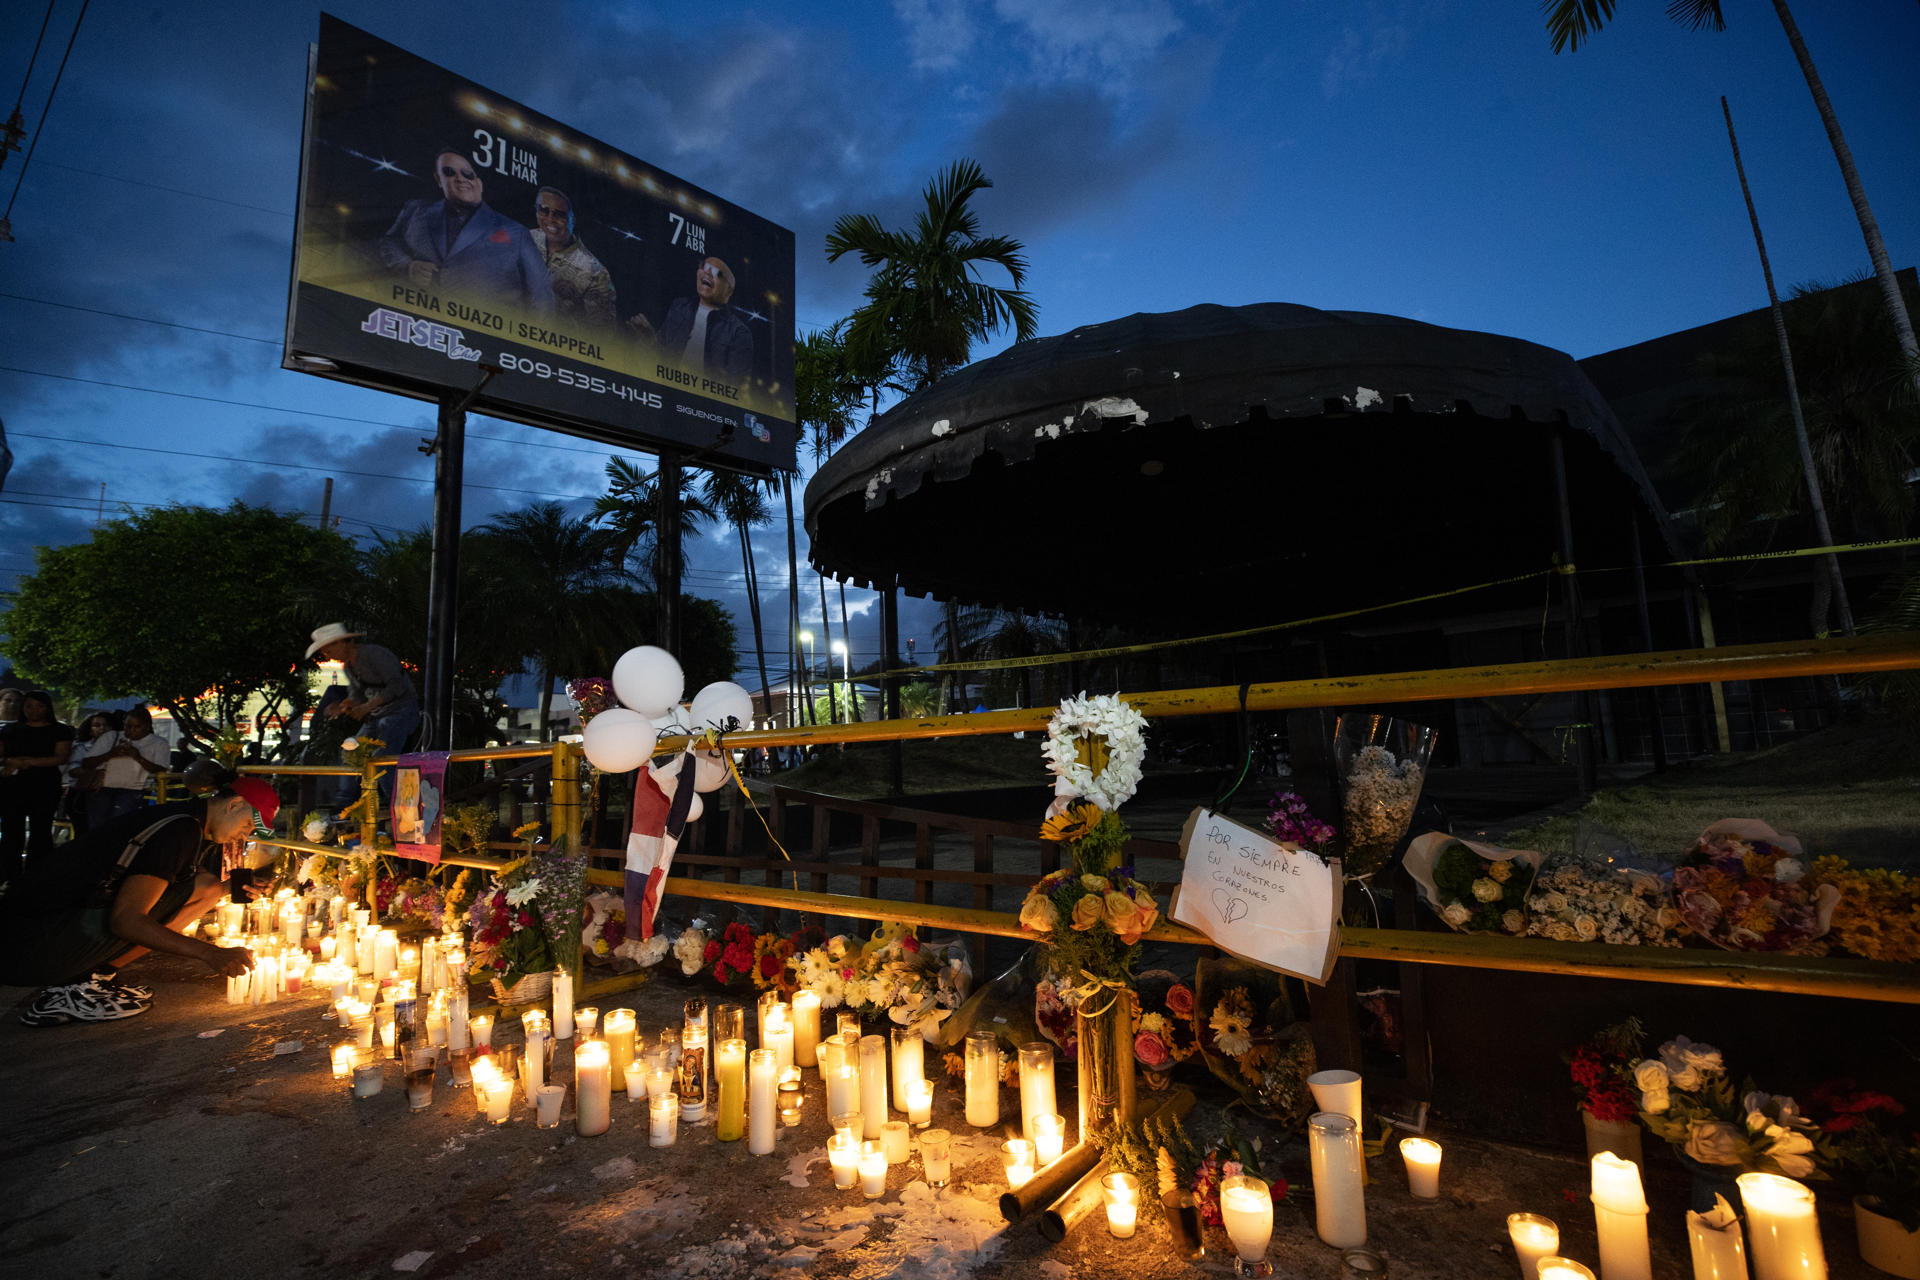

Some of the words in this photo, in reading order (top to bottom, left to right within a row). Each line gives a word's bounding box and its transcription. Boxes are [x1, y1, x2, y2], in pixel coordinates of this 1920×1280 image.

[472, 129, 508, 176] 31
[512, 146, 537, 170] LUN
[511, 161, 538, 186] MAR
[669, 212, 684, 245] 7
[686, 221, 705, 242] LUN
[685, 235, 705, 255] ABR
[392, 284, 440, 313] PEÑA
[447, 301, 503, 331] SUAZO
[518, 322, 604, 361] SEXAPPEAL
[448, 344, 482, 361] Club
[499, 352, 663, 409] 809-535-4145
[656, 364, 698, 388] RUBBY
[702, 378, 738, 401] PEREZ
[1206, 825, 1232, 851] POR
[1208, 850, 1221, 865] EN
[1233, 865, 1286, 893] NUESTROS
